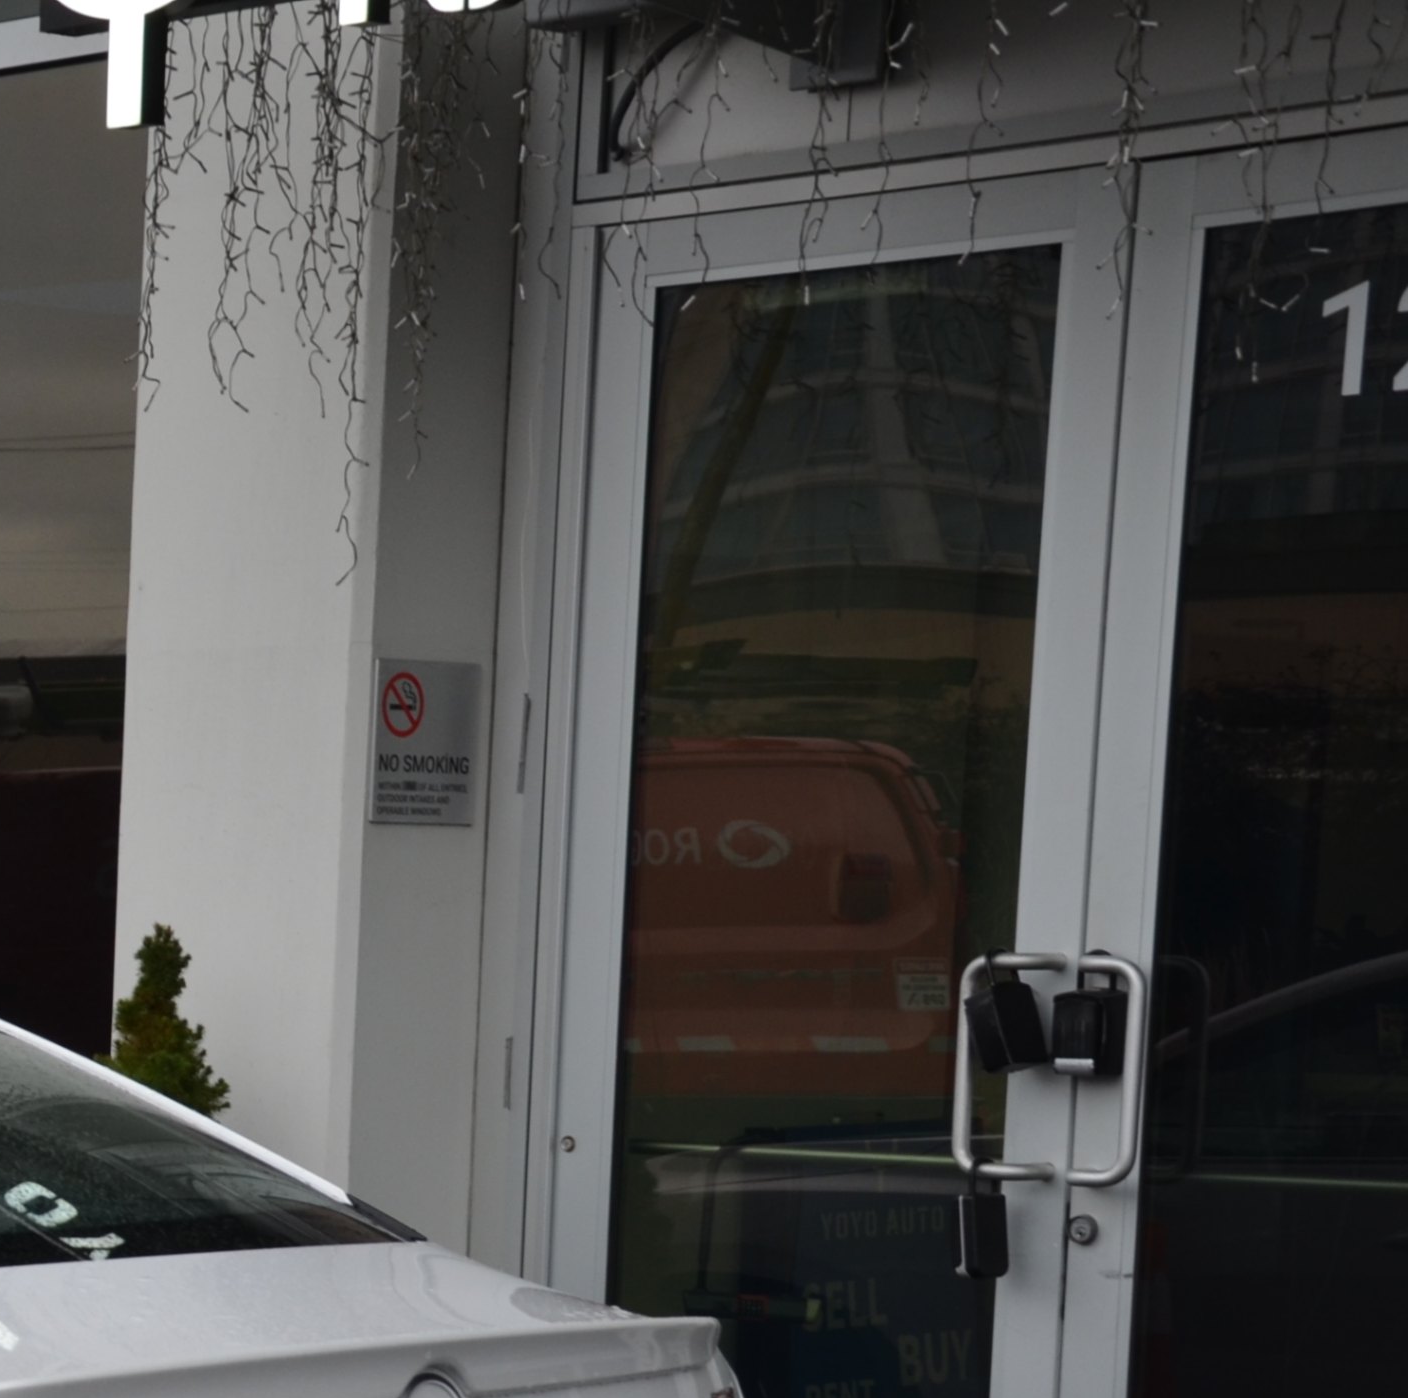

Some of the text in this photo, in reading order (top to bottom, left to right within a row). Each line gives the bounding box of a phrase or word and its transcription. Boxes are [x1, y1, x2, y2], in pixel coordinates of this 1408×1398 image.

[1321, 279, 1408, 396] 1
[378, 753, 470, 776] NO SMOKING
[820, 1203, 946, 1241] YOYO AUTO
[802, 1277, 888, 1333] SELL
[896, 1328, 972, 1388] BUY
